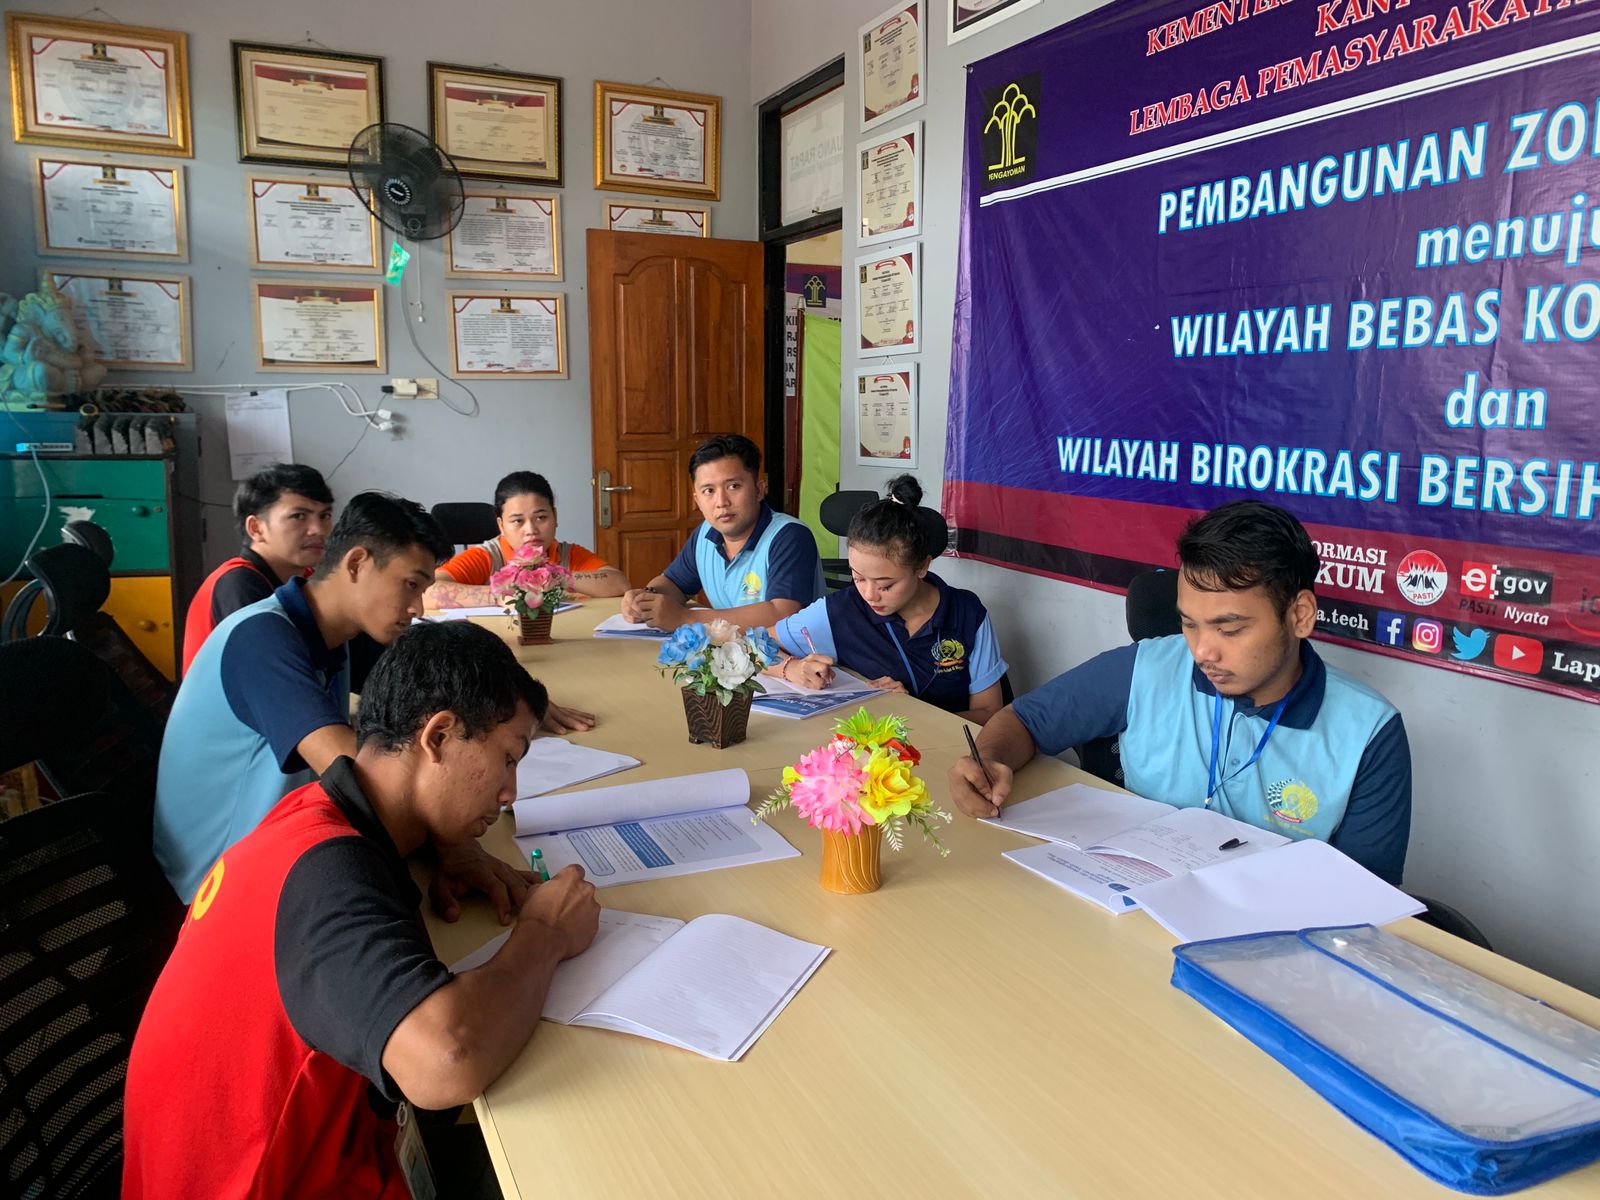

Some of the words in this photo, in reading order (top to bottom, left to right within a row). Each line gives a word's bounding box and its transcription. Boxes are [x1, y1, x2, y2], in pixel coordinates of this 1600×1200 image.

[1315, 0, 1410, 36] KAN
[1129, 75, 1251, 136] LEMBAGA
[1256, 0, 1598, 98] PEMASYARAKA
[1158, 122, 1488, 234] PEMBANGUNAN
[1171, 303, 1332, 358] WILAYAH
[1347, 288, 1500, 350] BEBAS
[1444, 371, 1548, 429] dan
[1057, 436, 1179, 482] WILAYAH
[1190, 442, 1400, 502] BIROKRASI
[1459, 598, 1497, 616] PASTI
[1504, 606, 1549, 626] Nyata
[1503, 575, 1548, 595] gov
